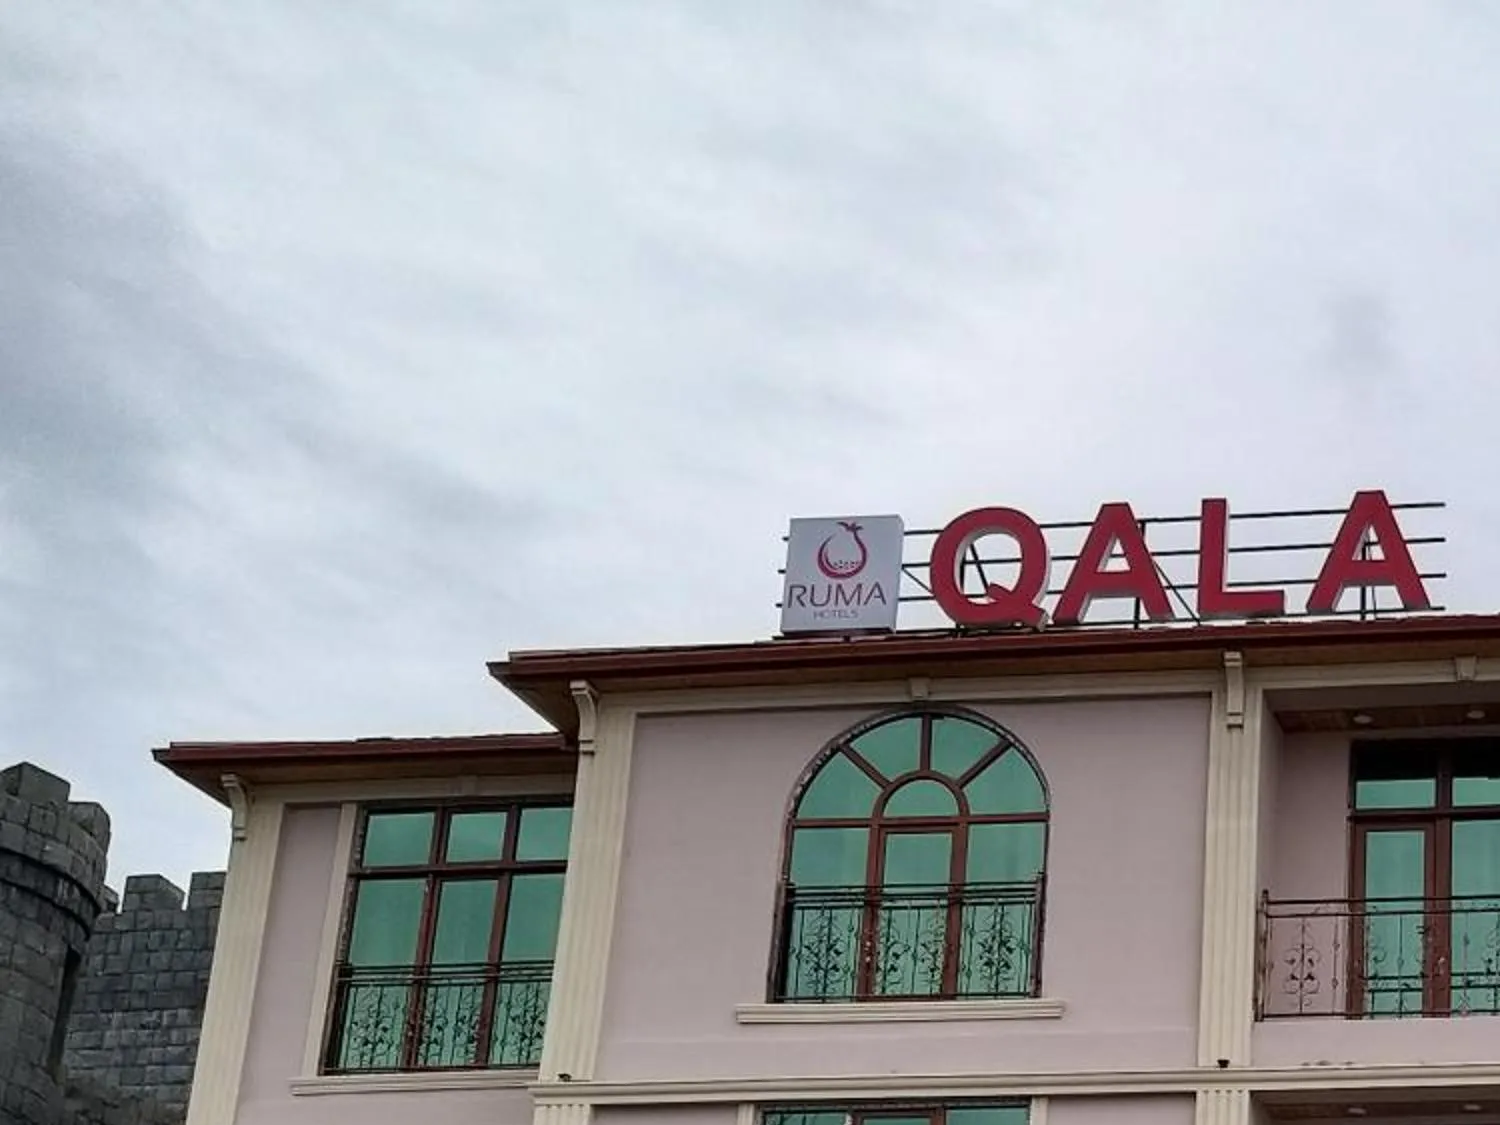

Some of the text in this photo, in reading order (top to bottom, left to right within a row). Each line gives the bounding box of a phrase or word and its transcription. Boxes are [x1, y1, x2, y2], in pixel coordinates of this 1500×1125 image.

[930, 489, 1432, 630] QALA
[787, 581, 887, 609] RUMA
[812, 608, 860, 620] HOTELS
